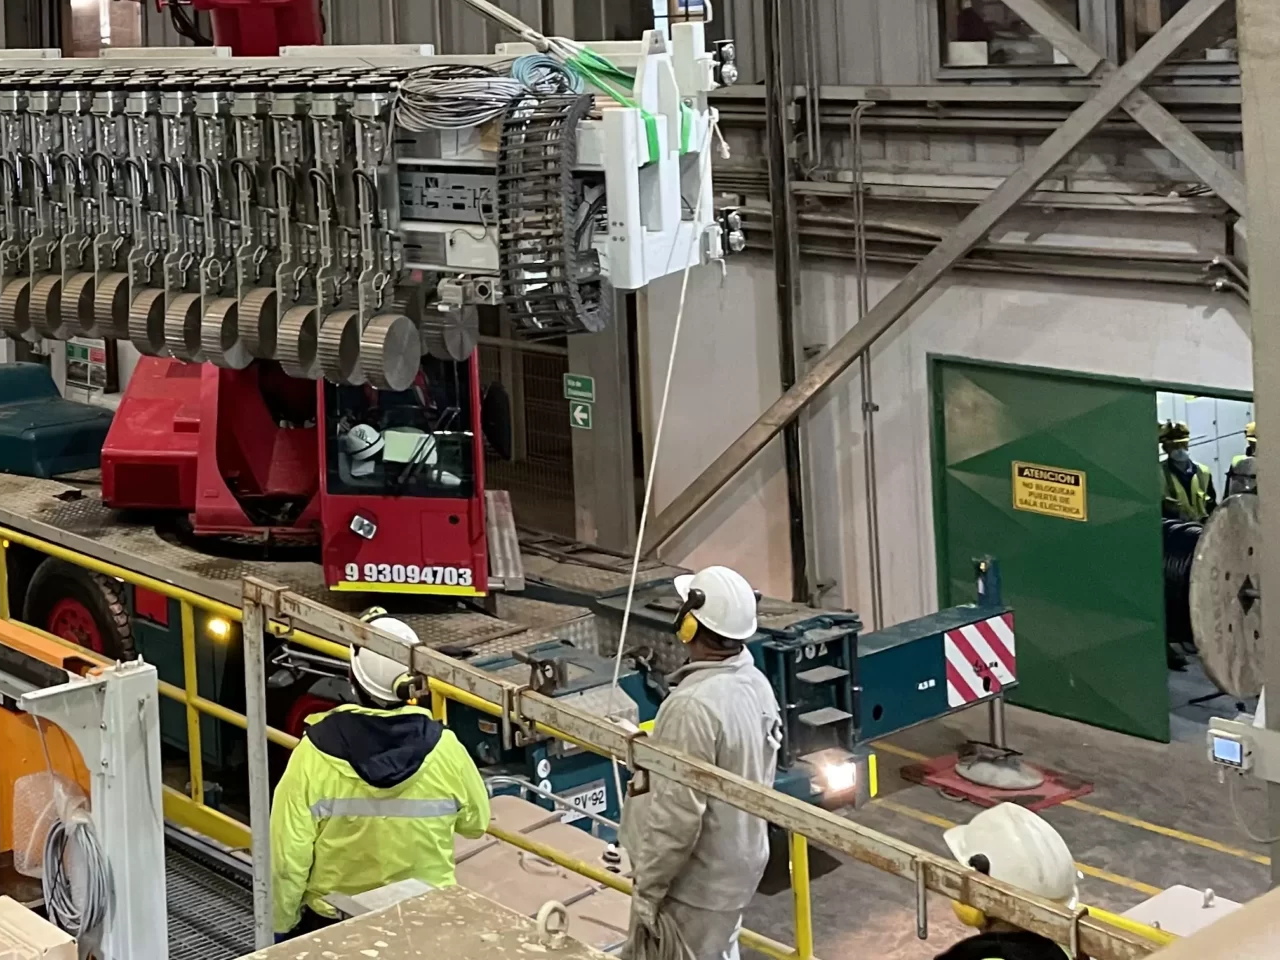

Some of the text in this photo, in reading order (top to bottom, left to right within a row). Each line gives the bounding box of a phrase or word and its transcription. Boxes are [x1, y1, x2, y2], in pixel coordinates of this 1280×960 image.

[1023, 468, 1075, 484] ATENCION
[1022, 481, 1076, 496] NO BLOQUEAR
[1019, 498, 1038, 508] SALA
[1028, 491, 1070, 504] PUERTA DE
[345, 563, 472, 586] 9 93094703
